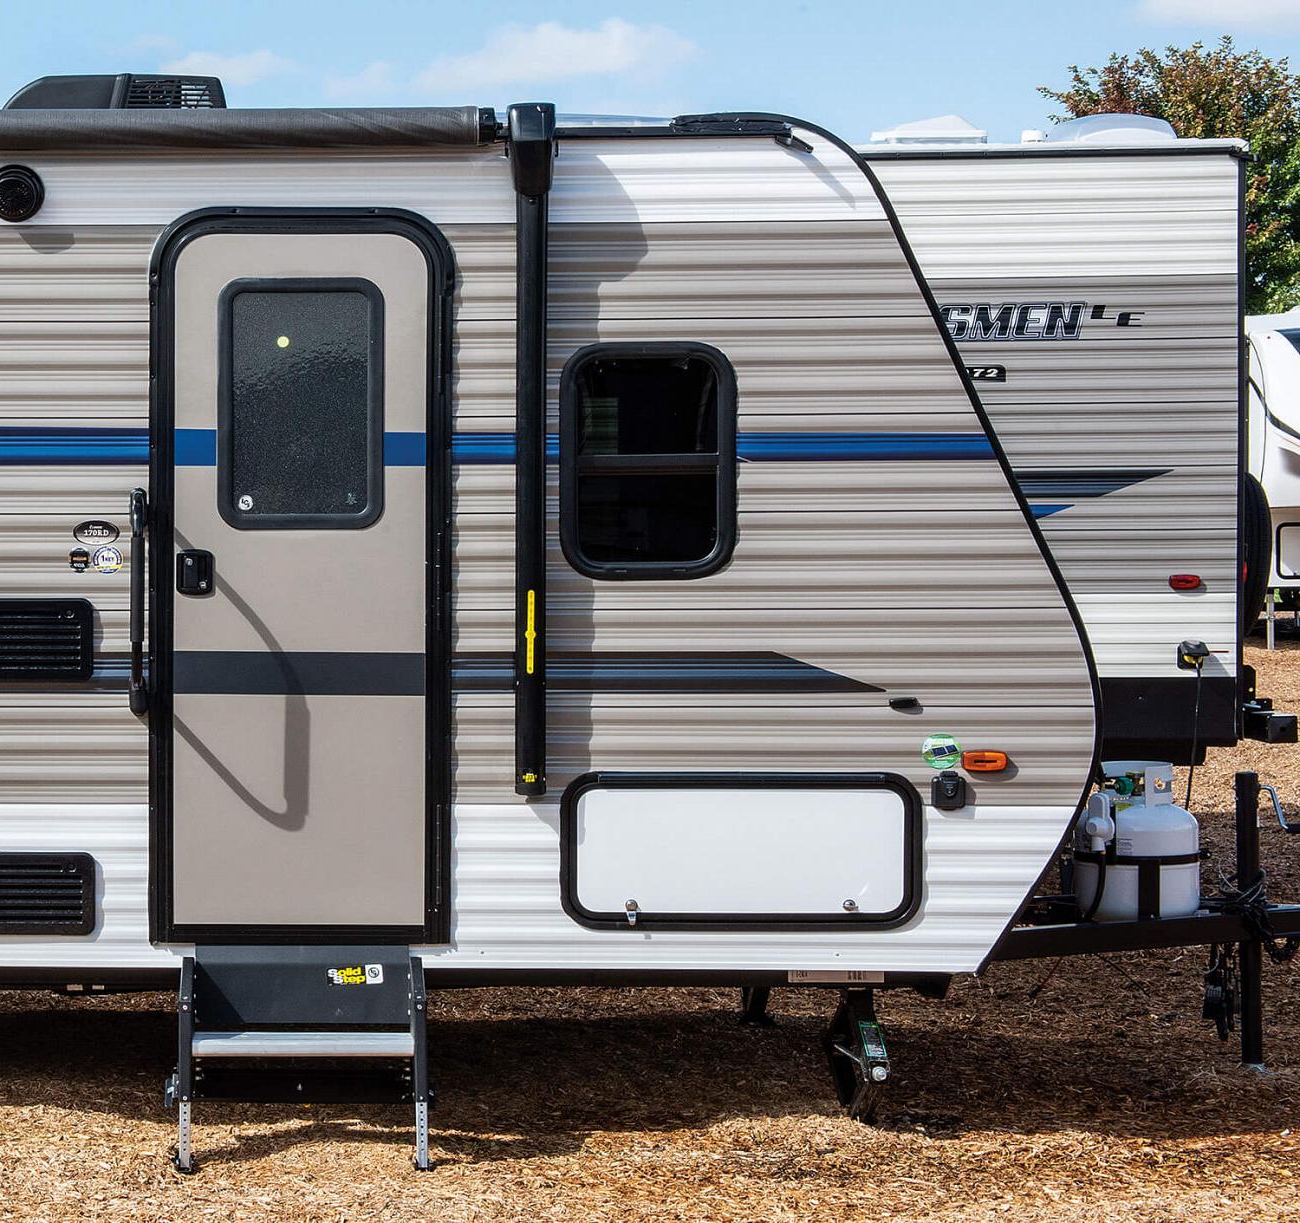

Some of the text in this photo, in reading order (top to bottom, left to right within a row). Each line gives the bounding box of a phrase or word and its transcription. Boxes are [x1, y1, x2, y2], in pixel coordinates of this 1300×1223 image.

[1091, 304, 1145, 327] LE
[968, 368, 999, 378] 72
[327, 967, 362, 977] Solid
[333, 976, 366, 984] Step
